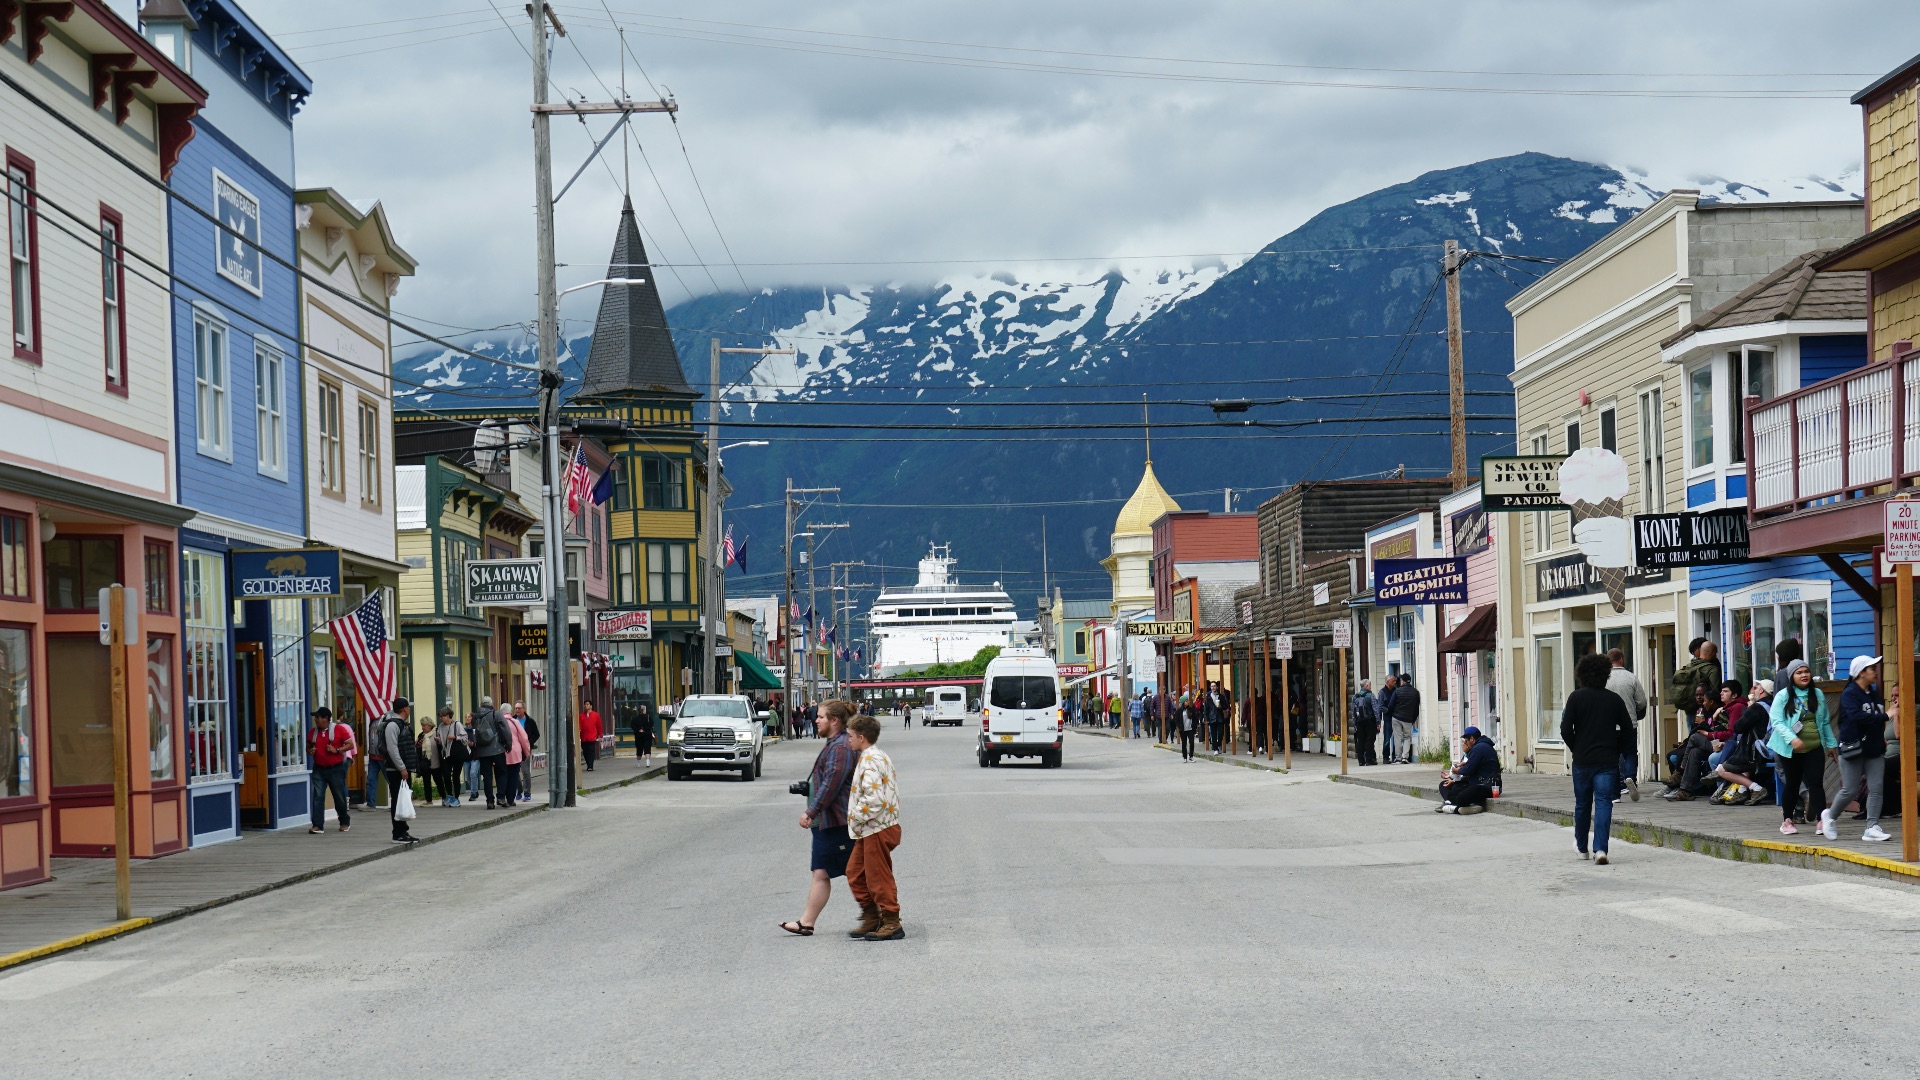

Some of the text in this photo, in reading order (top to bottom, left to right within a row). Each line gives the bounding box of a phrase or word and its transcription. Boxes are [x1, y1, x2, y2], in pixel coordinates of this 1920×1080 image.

[240, 197, 256, 220] EAGLE
[226, 256, 252, 284] NATIVE ART
[1494, 462, 1564, 472] SKAGWA
[1494, 472, 1558, 482] JEWEL
[1525, 482, 1549, 492] CO.
[1503, 496, 1564, 505] PANDOR
[1899, 507, 1911, 518] 20
[1639, 514, 1747, 548] KONE KOMPAN
[1892, 520, 1918, 530] MINUTE
[1890, 532, 1920, 542] PARKING
[1654, 553, 1666, 563] ICE
[1669, 551, 1690, 562] CREAM
[1700, 550, 1719, 560] CANDY
[471, 566, 540, 587] SKAGWAY
[1384, 562, 1455, 585] CREATIVE
[1541, 562, 1585, 591] SKAGWAY
[242, 579, 331, 594] GOLDEN BEAR
[487, 584, 525, 592] TOURS
[1379, 573, 1463, 599] GOLDSMITH
[1751, 588, 1800, 605] SWEET SOUVENIR
[597, 612, 647, 634] HARDWARE
[1138, 623, 1190, 635] PANTHEON
